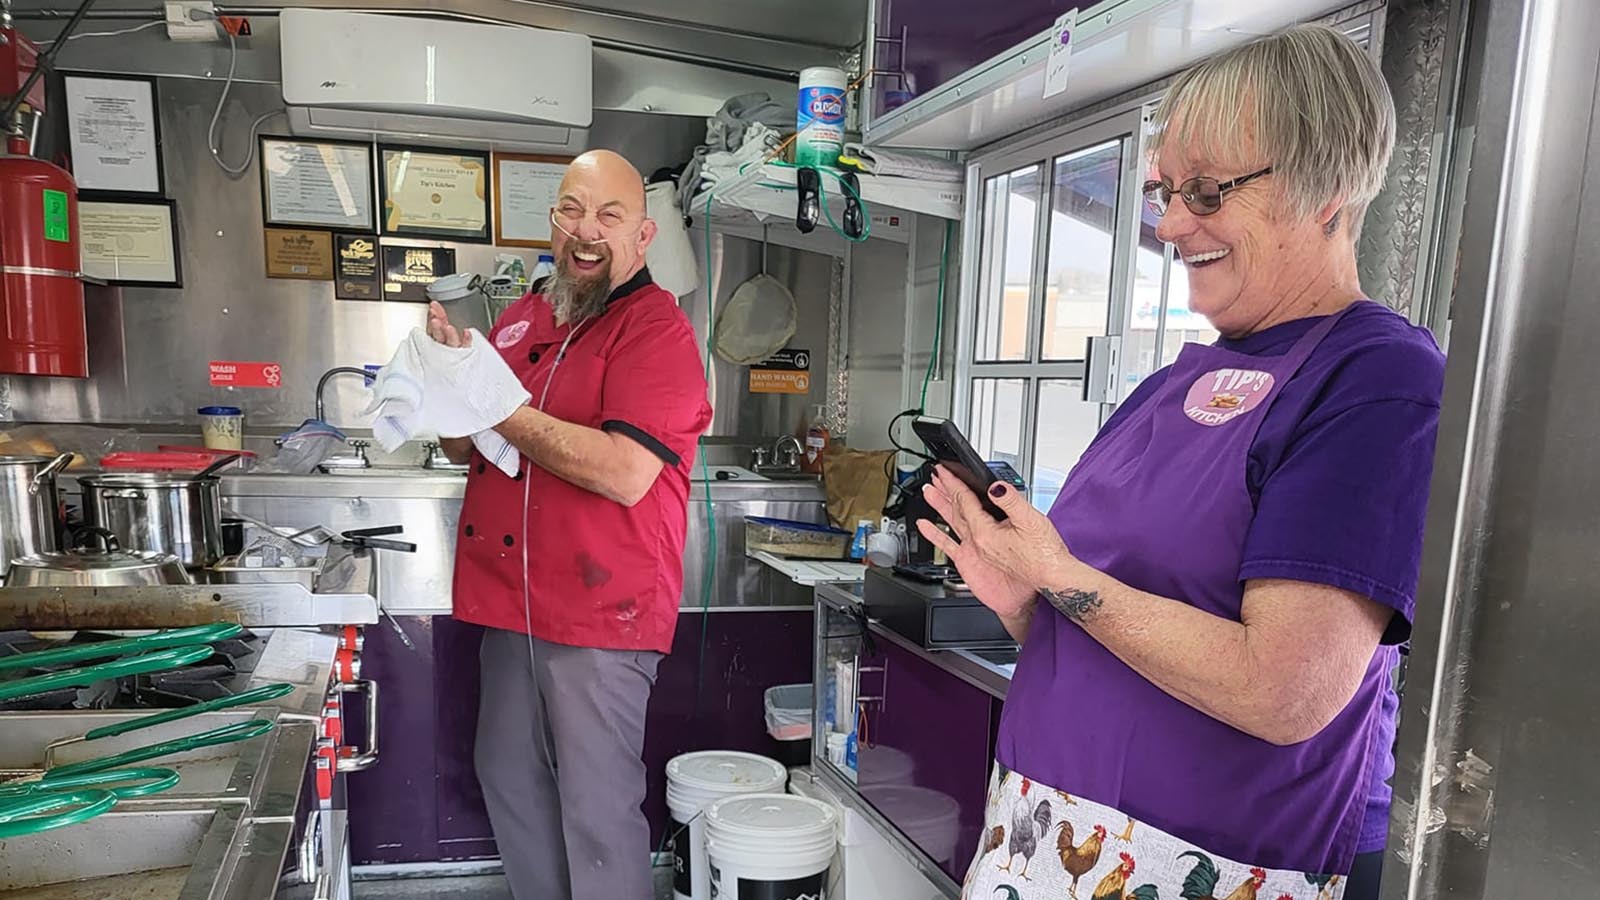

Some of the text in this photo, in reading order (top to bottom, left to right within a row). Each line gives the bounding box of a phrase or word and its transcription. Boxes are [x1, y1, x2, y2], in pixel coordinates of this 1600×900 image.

[210, 365, 237, 374] WASH
[773, 374, 796, 382] WASH
[1211, 367, 1269, 392] TIP'S
[1185, 405, 1246, 424] KITCHEN
